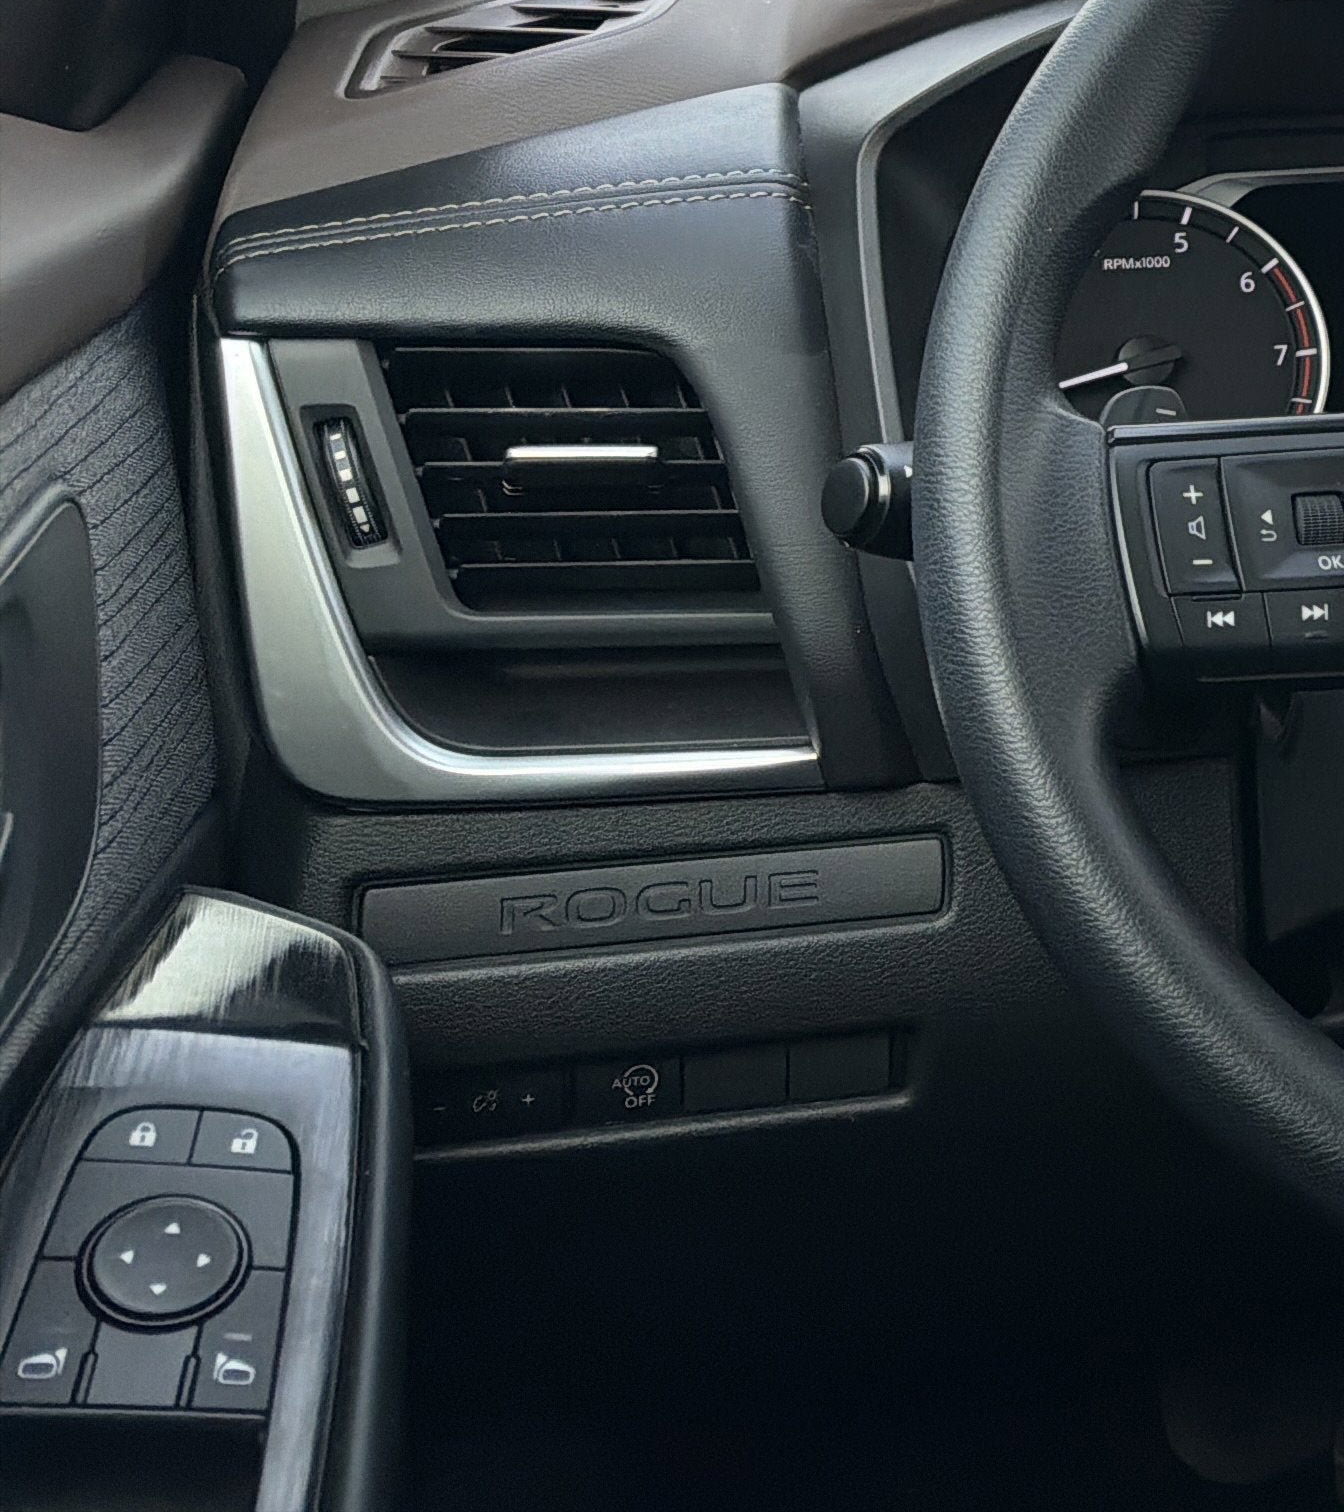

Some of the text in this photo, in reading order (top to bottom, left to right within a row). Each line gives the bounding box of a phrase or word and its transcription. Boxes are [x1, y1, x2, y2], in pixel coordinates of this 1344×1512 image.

[1173, 231, 1190, 254] 5
[1239, 271, 1256, 293] 6
[1274, 344, 1288, 367] 7
[1317, 554, 1344, 571] OK
[499, 869, 821, 936] ROGUE
[612, 1073, 651, 1091] AUTO
[624, 1092, 657, 1110] OFF
